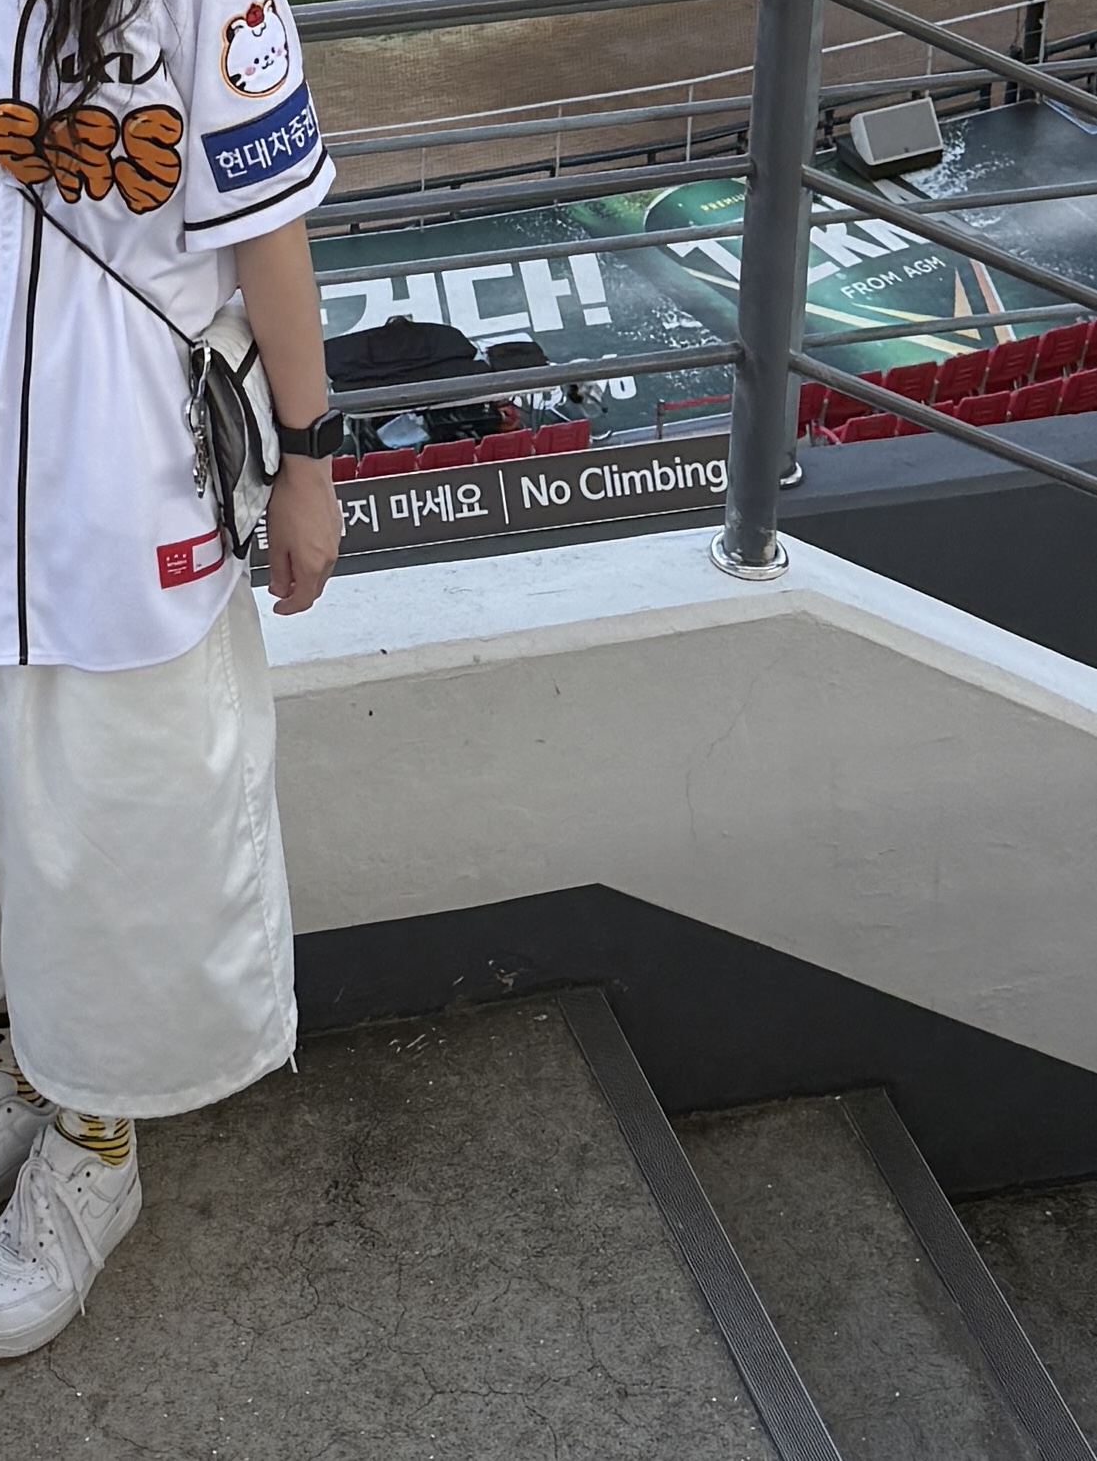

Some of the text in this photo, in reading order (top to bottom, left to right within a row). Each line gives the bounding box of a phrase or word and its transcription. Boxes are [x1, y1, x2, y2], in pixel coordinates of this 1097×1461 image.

[841, 254, 947, 299] FROM AGM
[391, 483, 489, 526] 마세요
[520, 474, 571, 510] No
[579, 457, 728, 501] Climbing
